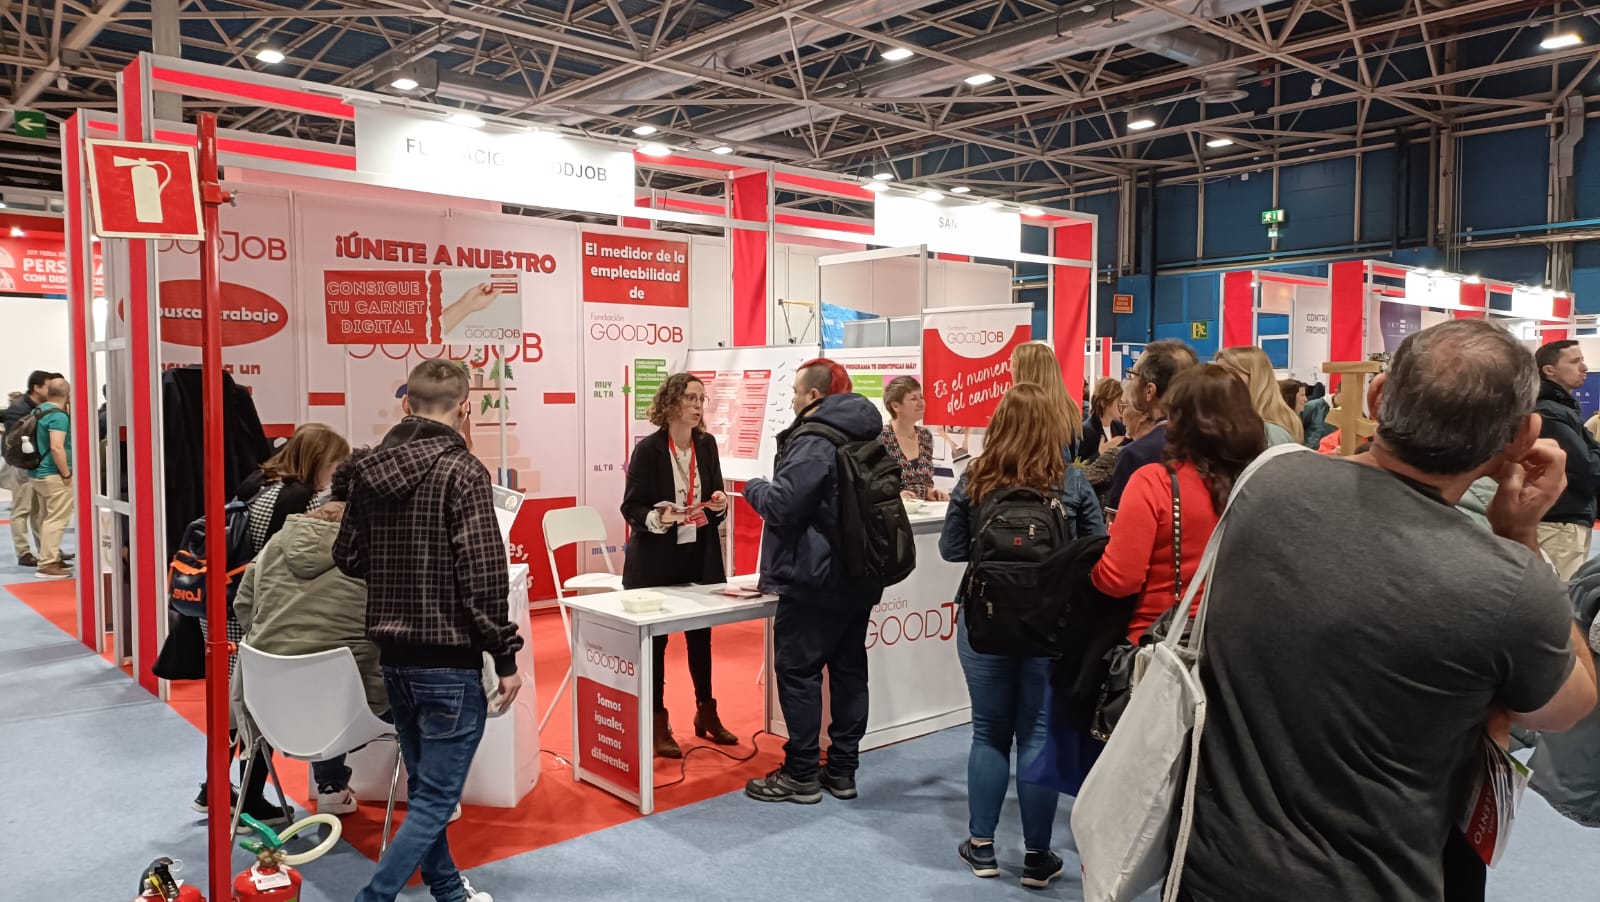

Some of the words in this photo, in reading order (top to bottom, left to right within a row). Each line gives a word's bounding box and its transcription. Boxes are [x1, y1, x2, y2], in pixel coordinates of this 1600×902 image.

[335, 230, 428, 265] ¡ÚNETE
[433, 244, 453, 266] A
[457, 245, 557, 276] NUESTRO
[585, 242, 598, 257] El
[600, 245, 653, 262] medidor
[656, 248, 671, 264] de
[674, 251, 686, 265] la
[23, 257, 68, 275] PERS
[590, 265, 681, 283] empleabilidad
[326, 281, 421, 297] CONSIGUE
[629, 285, 645, 300] de
[220, 305, 280, 324] rabajo
[328, 299, 350, 315] TU
[354, 299, 426, 315] CARNET
[341, 318, 415, 335] DIGITAL
[464, 327, 522, 341] GOODJOB
[590, 322, 684, 346] GOODJOB
[946, 329, 1005, 346] GOODJOB
[240, 363, 263, 375] un
[594, 380, 613, 389] MUY
[932, 379, 949, 399] Es
[951, 371, 964, 391] el
[593, 390, 614, 399] ALTA
[946, 390, 967, 416] del
[593, 463, 614, 472] ALTA
[864, 601, 961, 650] GOODJ
[586, 647, 636, 677] GOODJOB
[597, 692, 622, 713] Somos
[594, 710, 625, 735] iguales,
[598, 730, 622, 751] somos
[591, 746, 631, 773] diferentes
